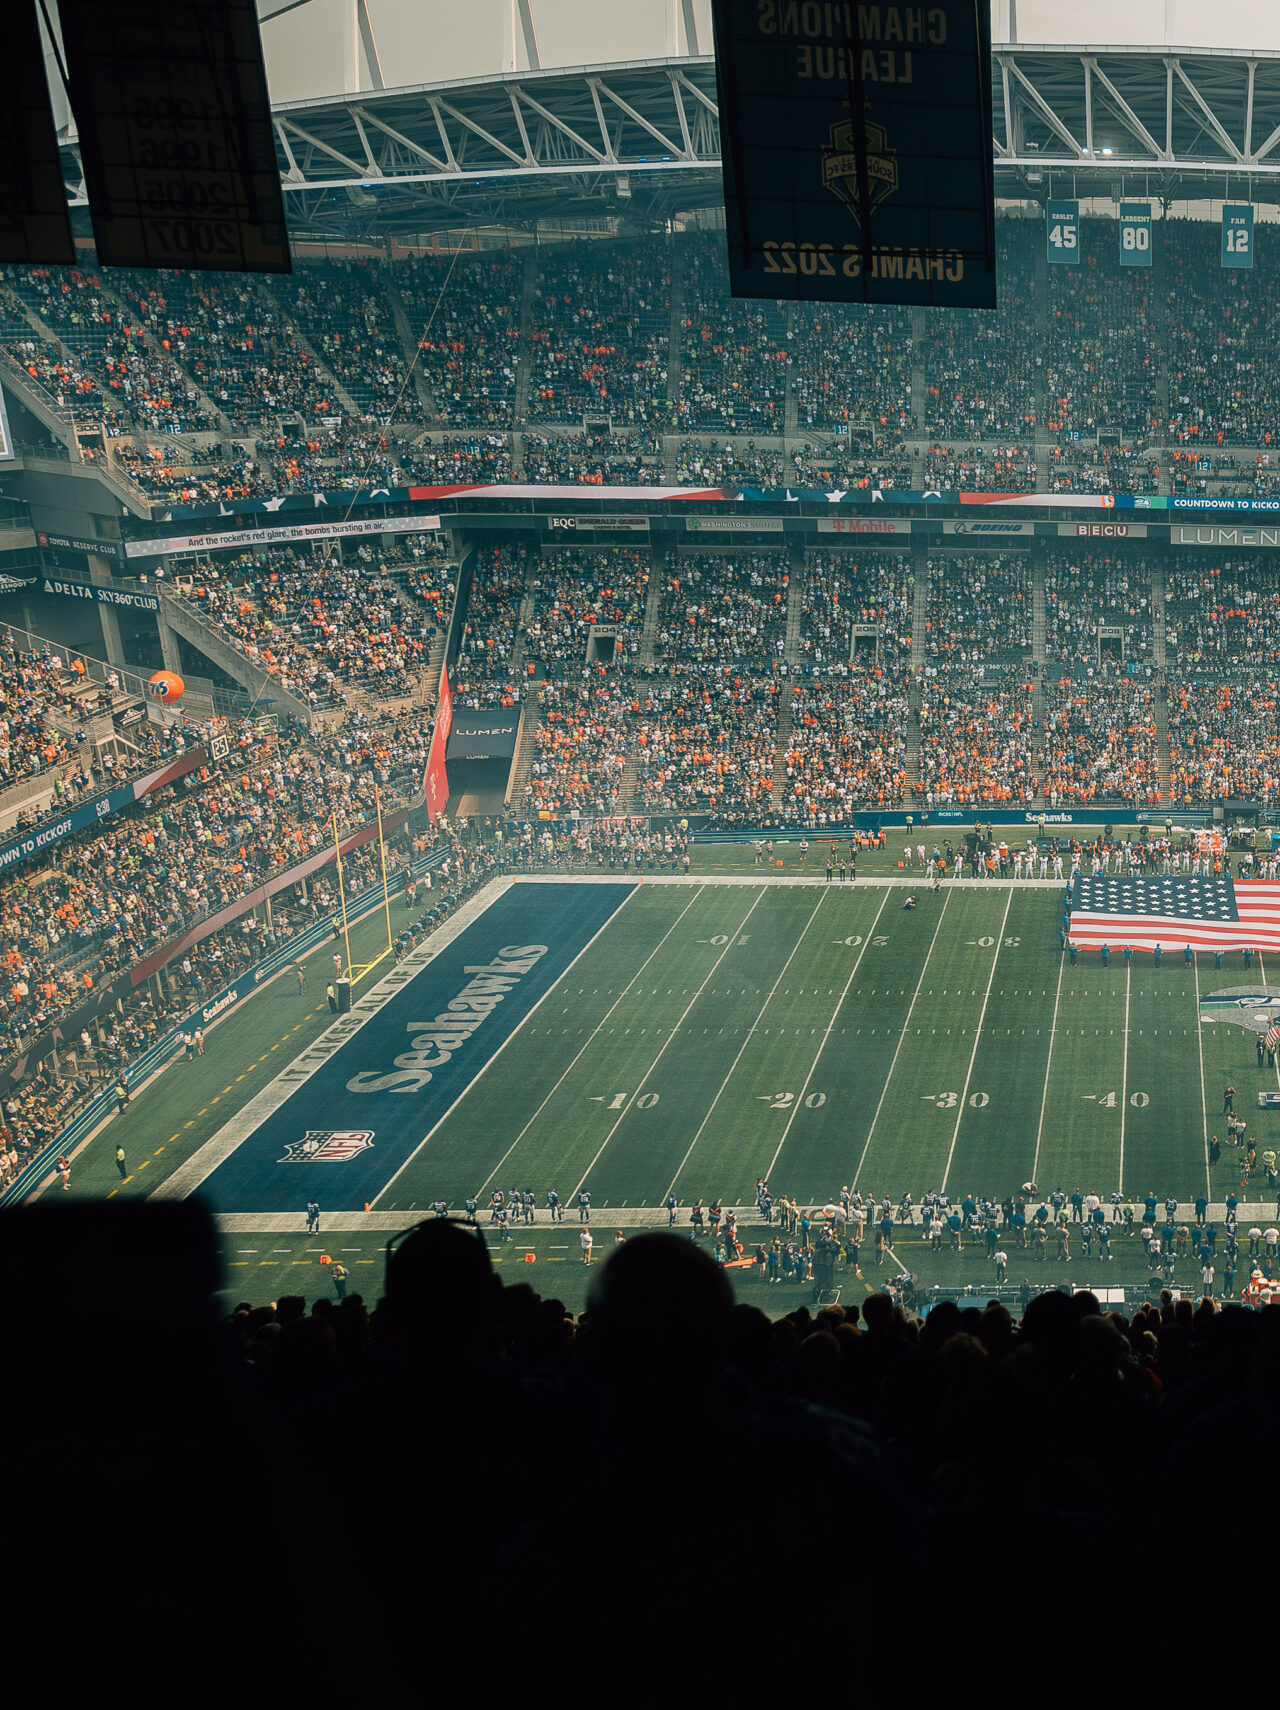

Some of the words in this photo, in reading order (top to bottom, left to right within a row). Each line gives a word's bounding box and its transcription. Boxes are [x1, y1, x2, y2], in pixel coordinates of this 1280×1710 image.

[1049, 225, 1076, 248] 45
[1122, 227, 1149, 251] 80
[1226, 229, 1248, 252] 12
[170, 424, 182, 435] 12
[380, 417, 391, 426] 12
[838, 425, 848, 434] 12
[1070, 431, 1079, 440] 12
[1198, 461, 1208, 471] 12
[1174, 499, 1234, 509] COUNTDOWN
[1237, 500, 1249, 509] TO
[553, 518, 576, 530] EQC
[188, 537, 204, 546] And
[206, 535, 218, 545] the
[220, 533, 250, 543] rocket's
[253, 530, 266, 541] red
[291, 528, 303, 537] the
[305, 526, 330, 536] bombs
[332, 523, 363, 535] bursting
[365, 522, 372, 530] in
[1180, 528, 1278, 545] LUMEN
[54, 582, 93, 599] DELTA
[134, 596, 158, 611] CLUB
[149, 681, 170, 697] 76
[456, 728, 513, 737] LUMEN
[214, 739, 226, 757] 25
[21, 840, 35, 854] TO
[36, 819, 72, 847] KICKOFF
[202, 990, 238, 1023] Seahawks
[278, 1068, 311, 1082] IT
[300, 1018, 364, 1061] TAKES
[354, 989, 397, 1012] ALL
[384, 970, 413, 984] OF
[403, 952, 435, 966] US
[345, 944, 549, 1093] Seahawks
[607, 1092, 660, 1110] 10
[769, 1092, 827, 1109] 20
[936, 1091, 990, 1109] 30
[1098, 1091, 1150, 1108] 40
[313, 1133, 366, 1158] NFL
